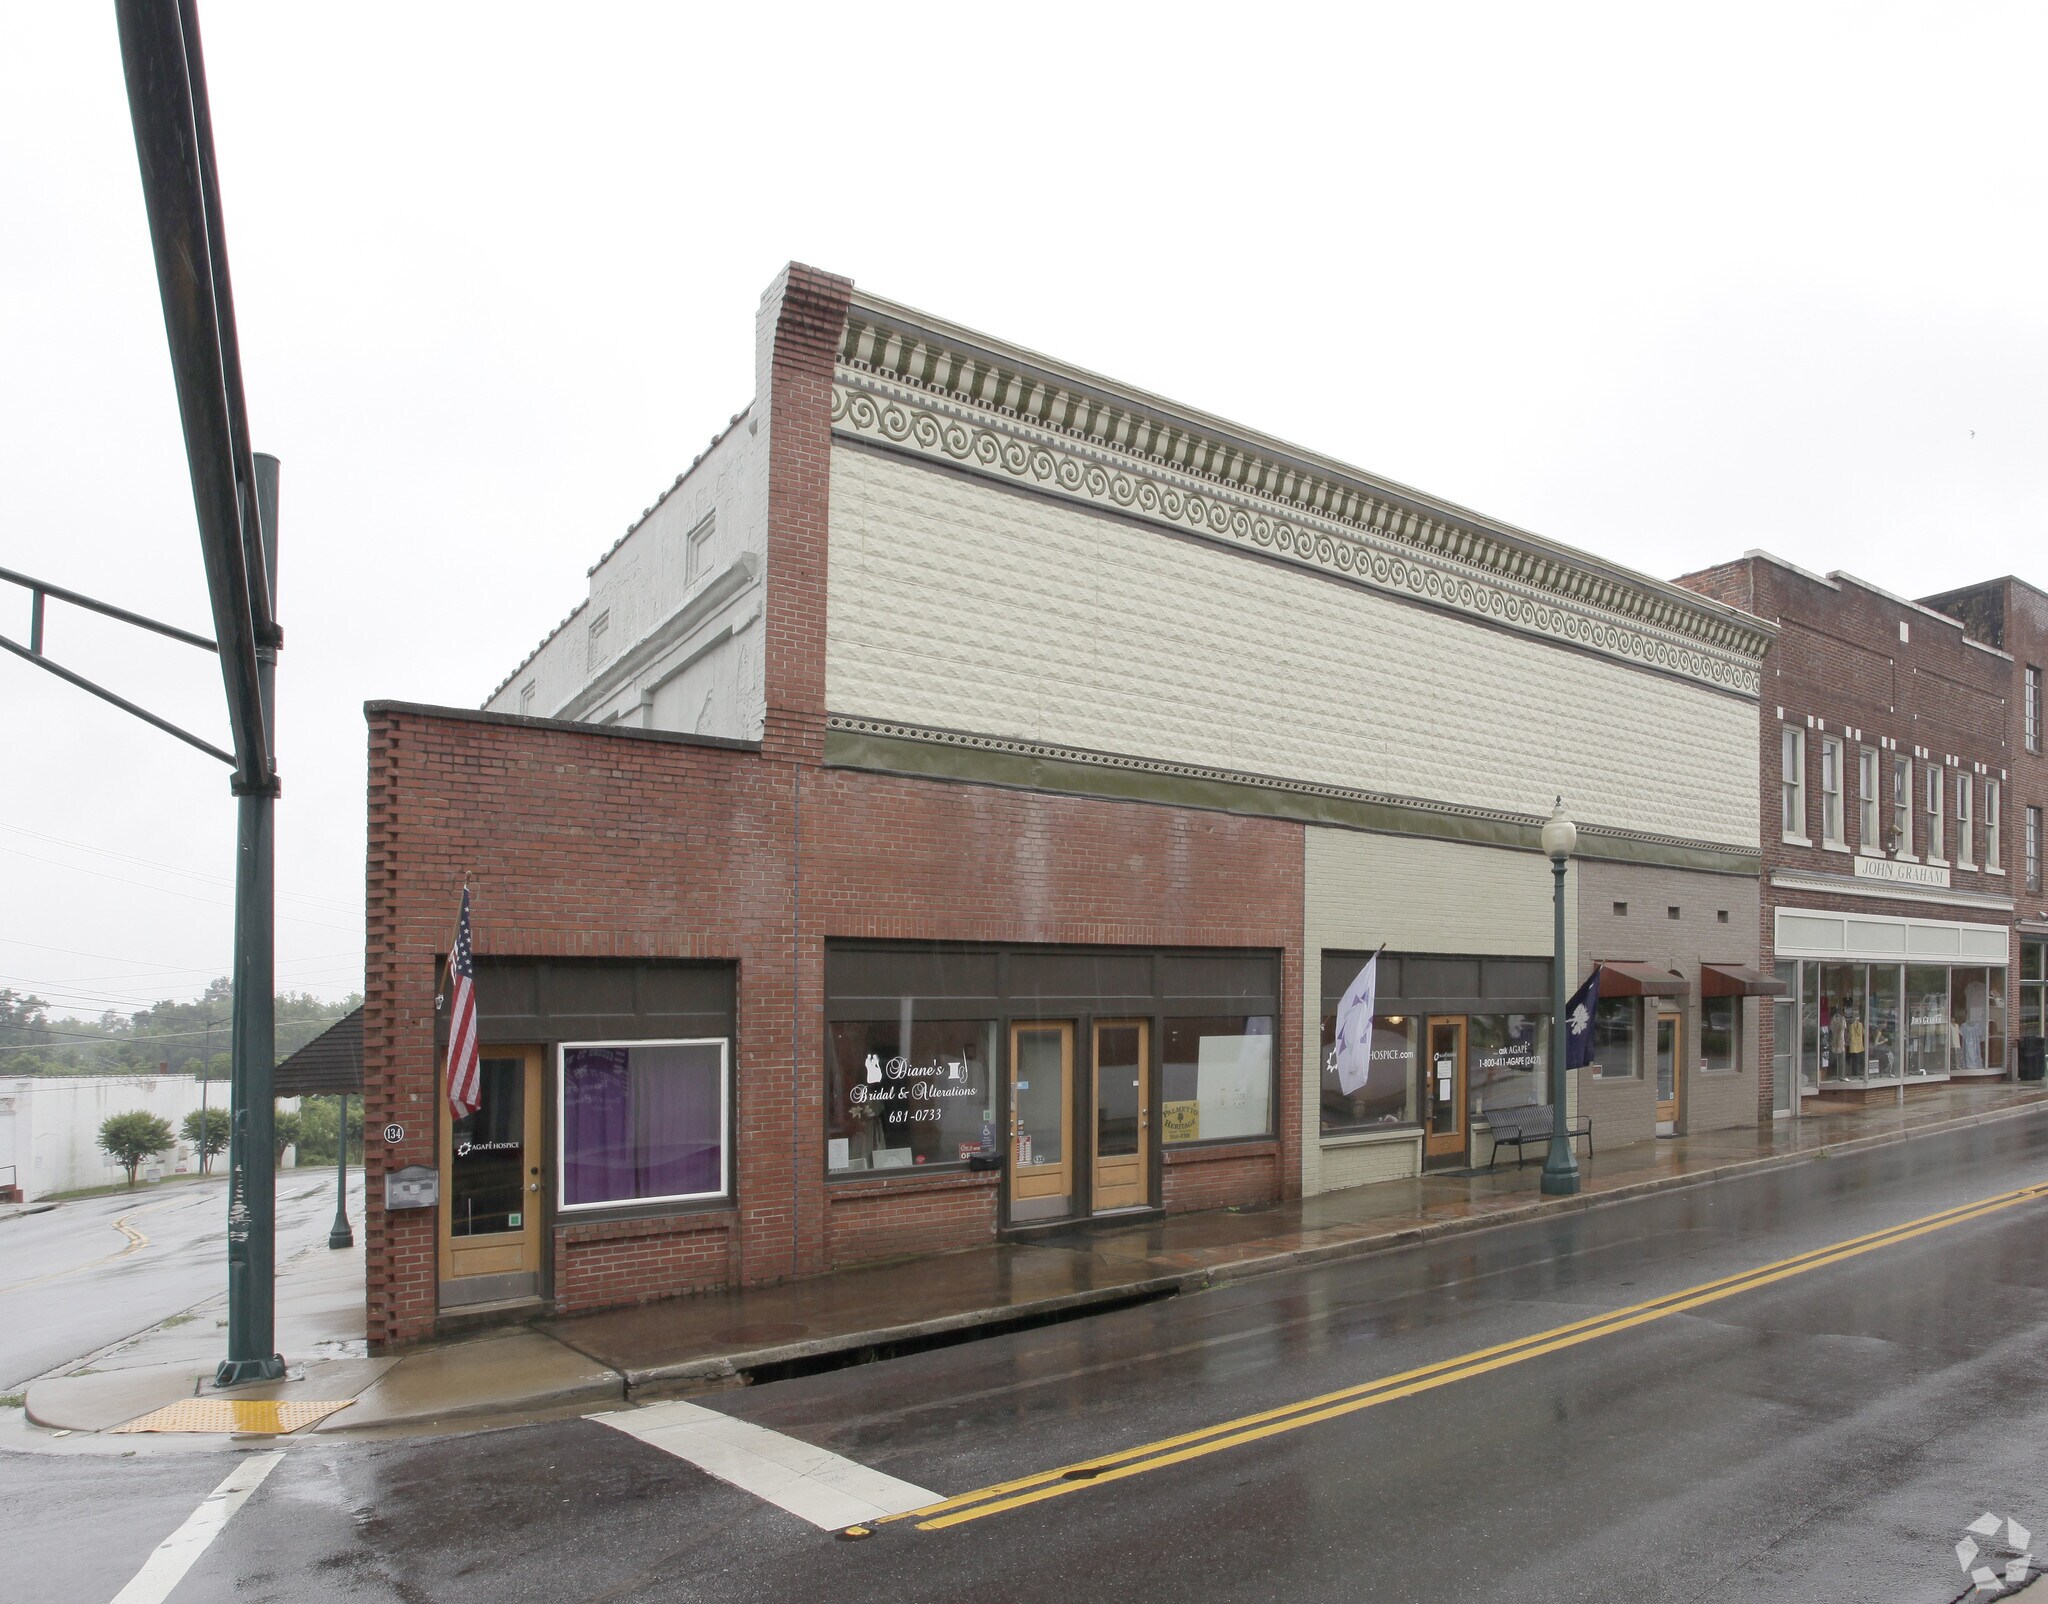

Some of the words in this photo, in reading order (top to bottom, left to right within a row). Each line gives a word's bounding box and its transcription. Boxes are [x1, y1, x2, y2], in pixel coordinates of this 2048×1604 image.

[1862, 861, 1893, 877] JOHN
[1897, 865, 1943, 883] GRAHAM
[886, 1056, 944, 1079] Diane's
[850, 1084, 895, 1103] Bridal
[898, 1087, 909, 1099] &
[912, 1081, 978, 1100] Alterations
[889, 1108, 942, 1123] 681-0733
[1163, 1107, 1198, 1118] PALMETTO
[1165, 1119, 1196, 1129] HERITAGE
[387, 1128, 401, 1139] 134
[493, 1141, 519, 1149] HOSPICE
